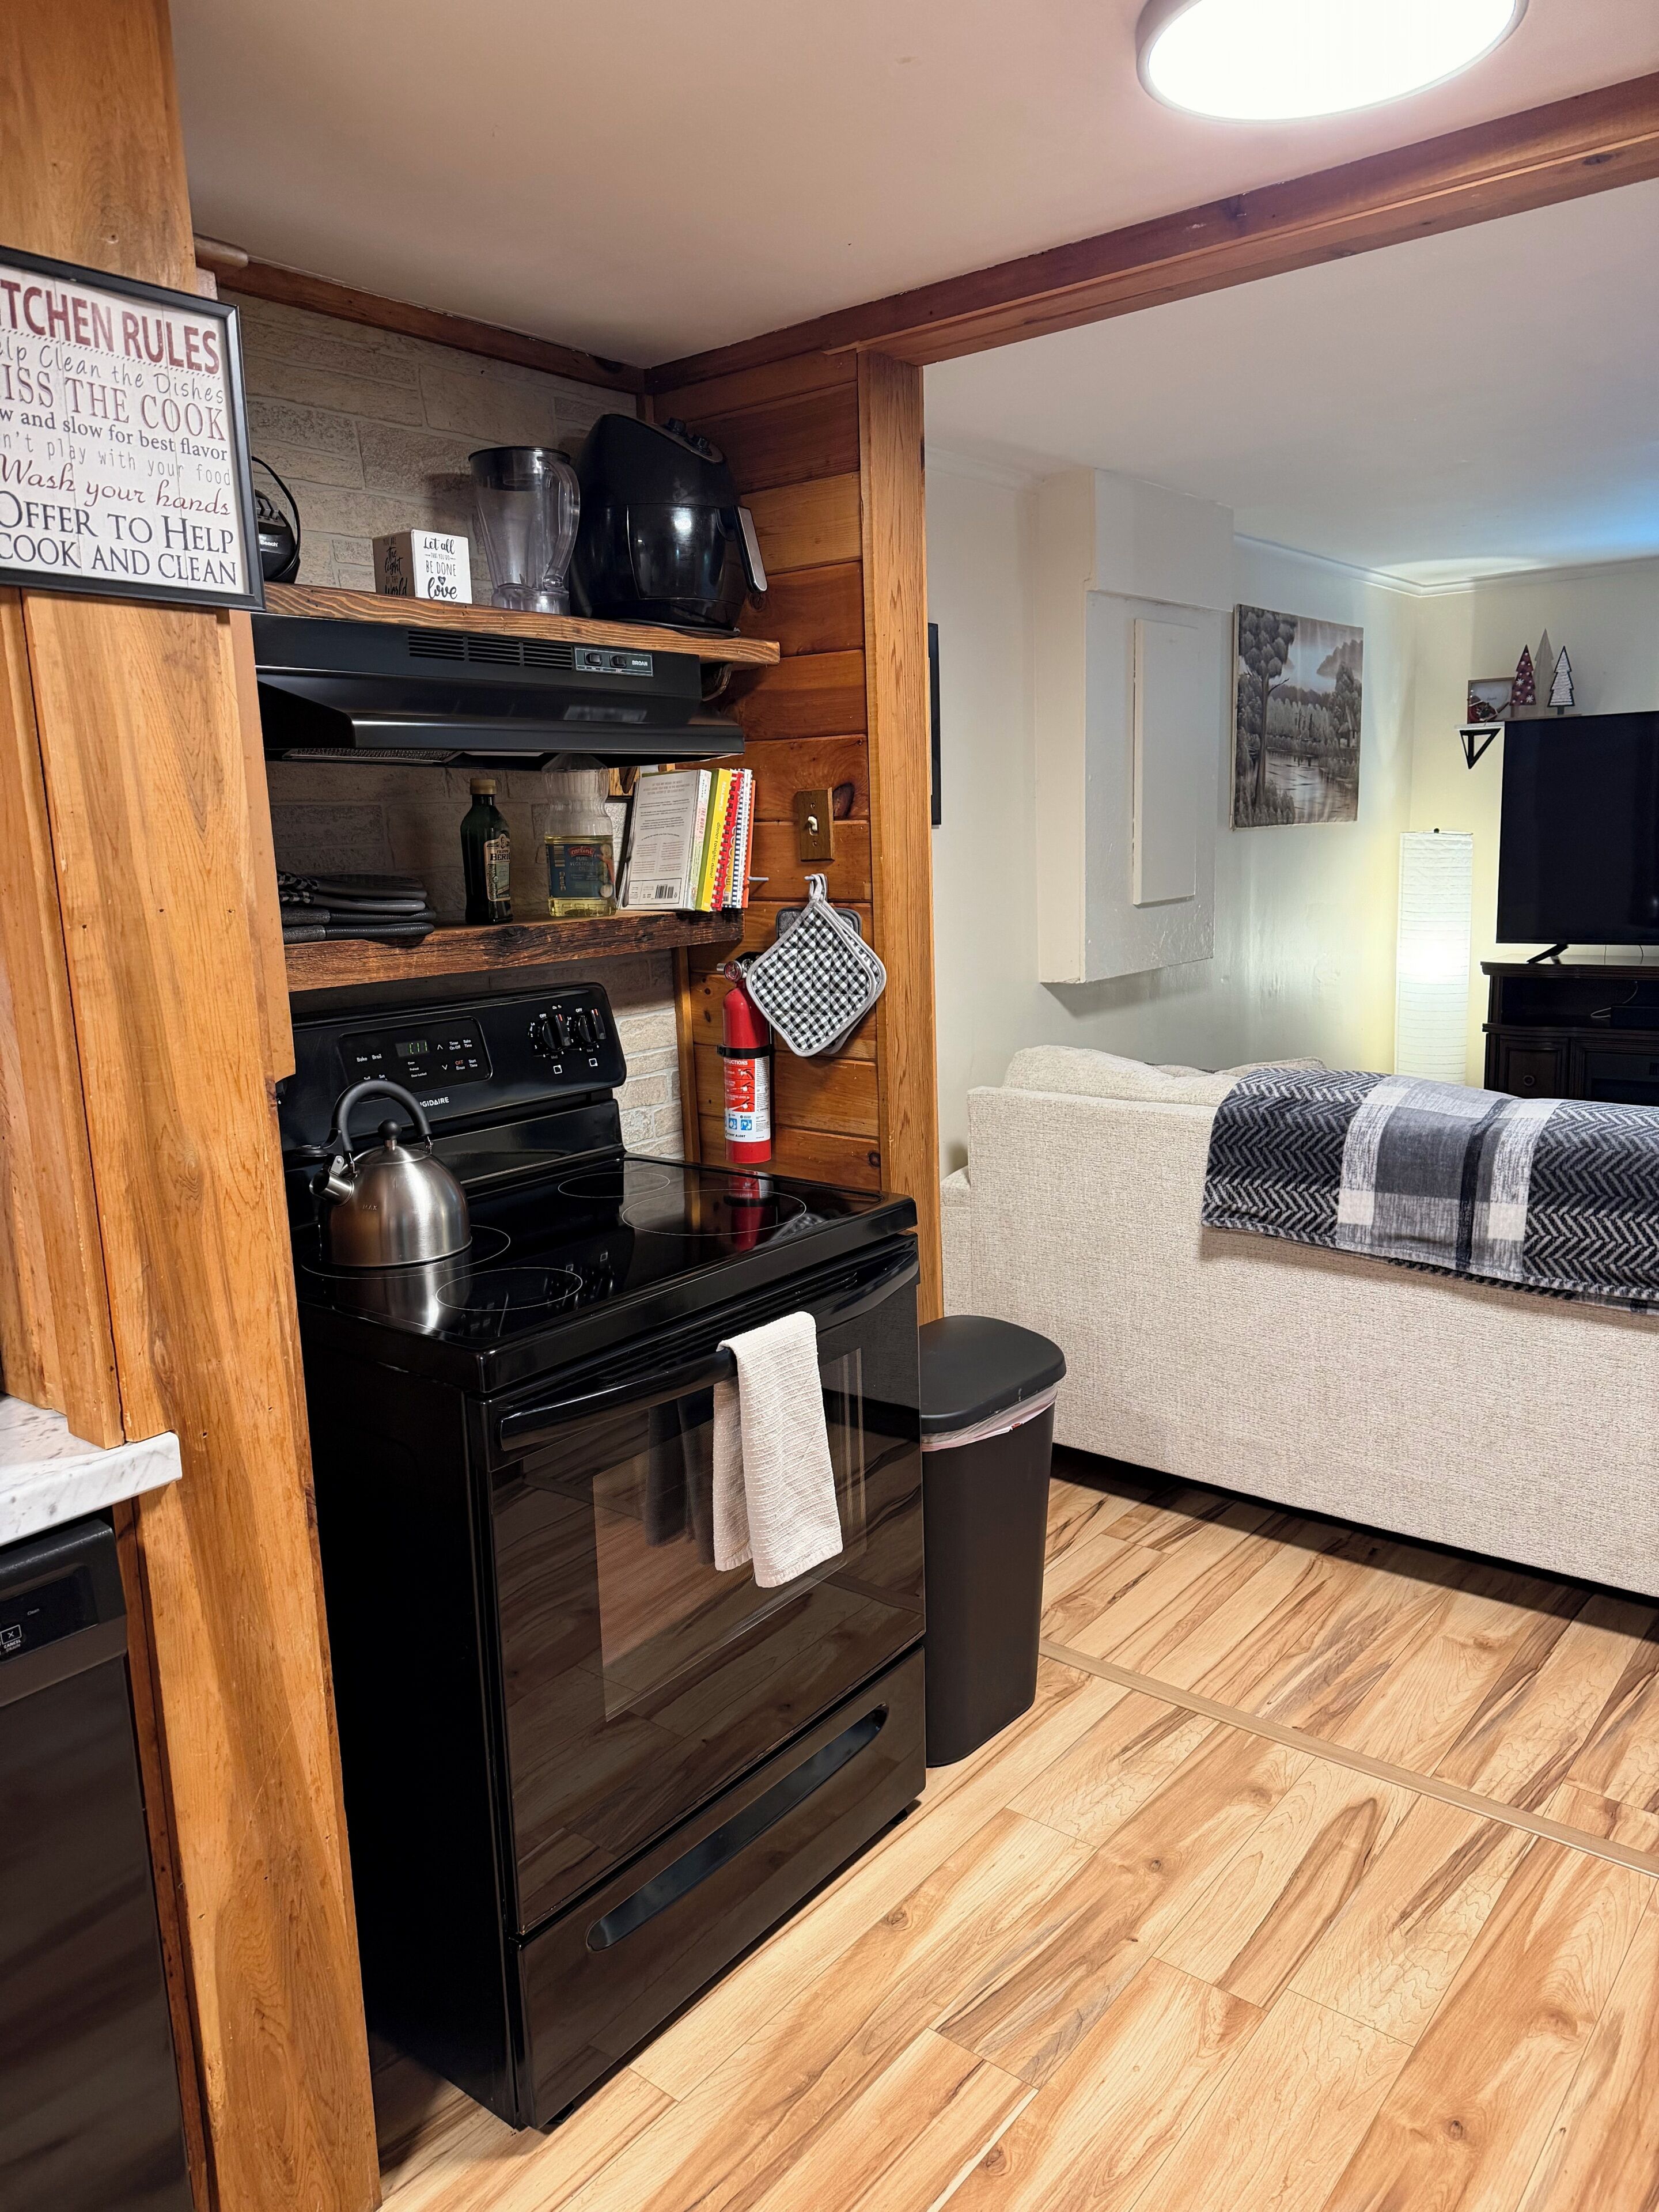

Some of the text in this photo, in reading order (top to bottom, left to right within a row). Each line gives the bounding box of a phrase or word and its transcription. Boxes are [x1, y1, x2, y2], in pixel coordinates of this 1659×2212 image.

[0, 279, 219, 374] TCHEN RULES
[40, 345, 101, 378] Clean
[112, 363, 143, 388] the
[153, 373, 224, 404] Dishes
[2, 363, 226, 441] ISS THE COOK
[0, 408, 228, 461] w and slow for best flavor
[3, 431, 230, 486] n't play with your food
[0, 453, 230, 515] Wash your hands
[107, 513, 153, 543] TO
[423, 537, 456, 555] Let all
[0, 532, 236, 586] COOK AND CLEAN
[426, 560, 457, 577] BE DONE
[427, 577, 458, 600] love
[419, 1097, 449, 1107] IGIDAIRE
[3, 1639, 21, 1649] CANCEL
